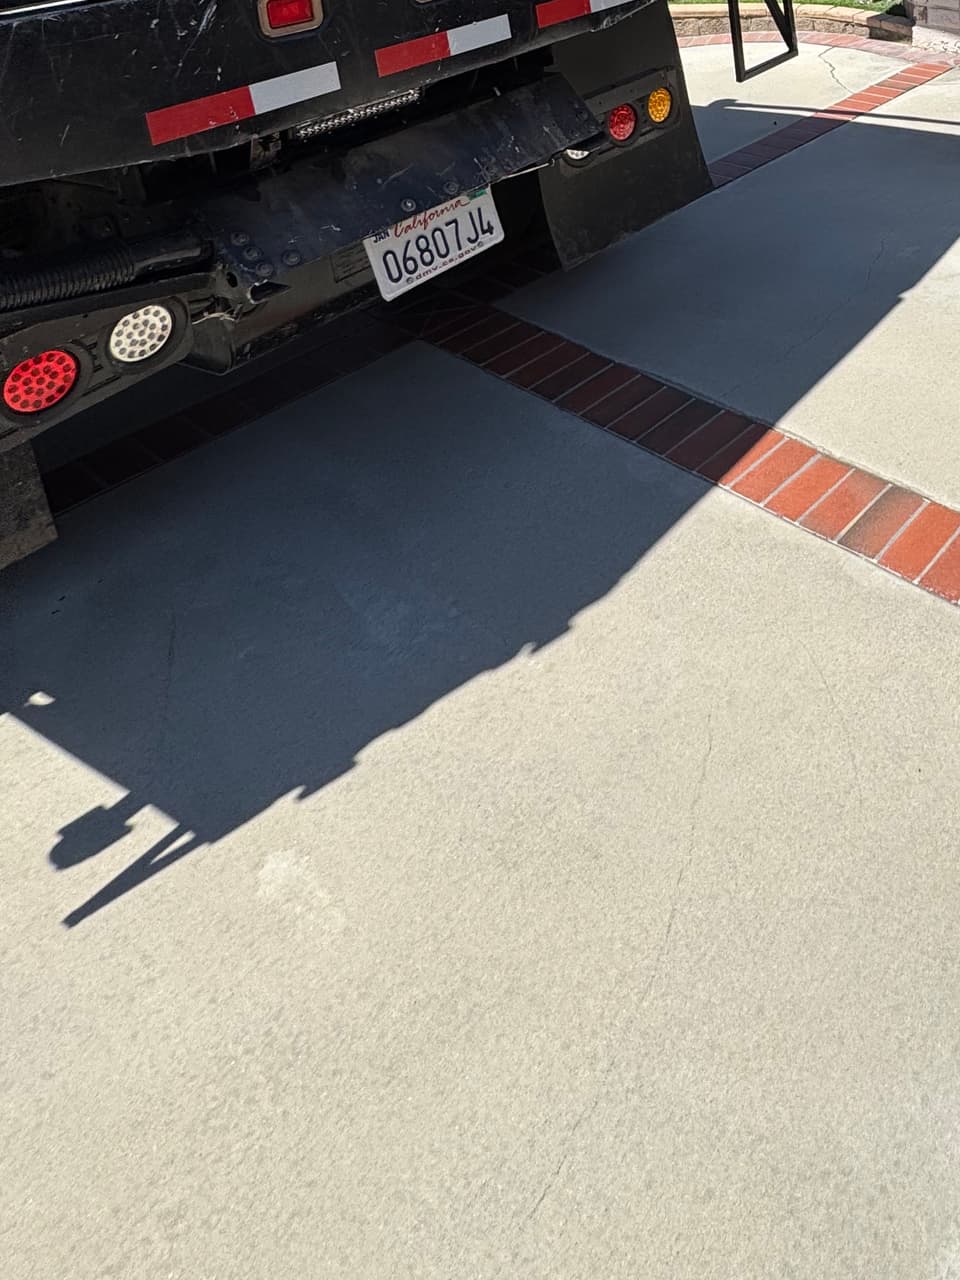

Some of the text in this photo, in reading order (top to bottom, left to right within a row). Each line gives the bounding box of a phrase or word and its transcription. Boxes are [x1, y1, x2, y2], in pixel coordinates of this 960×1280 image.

[393, 199, 470, 238] California
[382, 207, 495, 284] 06807J4
[415, 245, 477, 282] dmv.ca.gov
